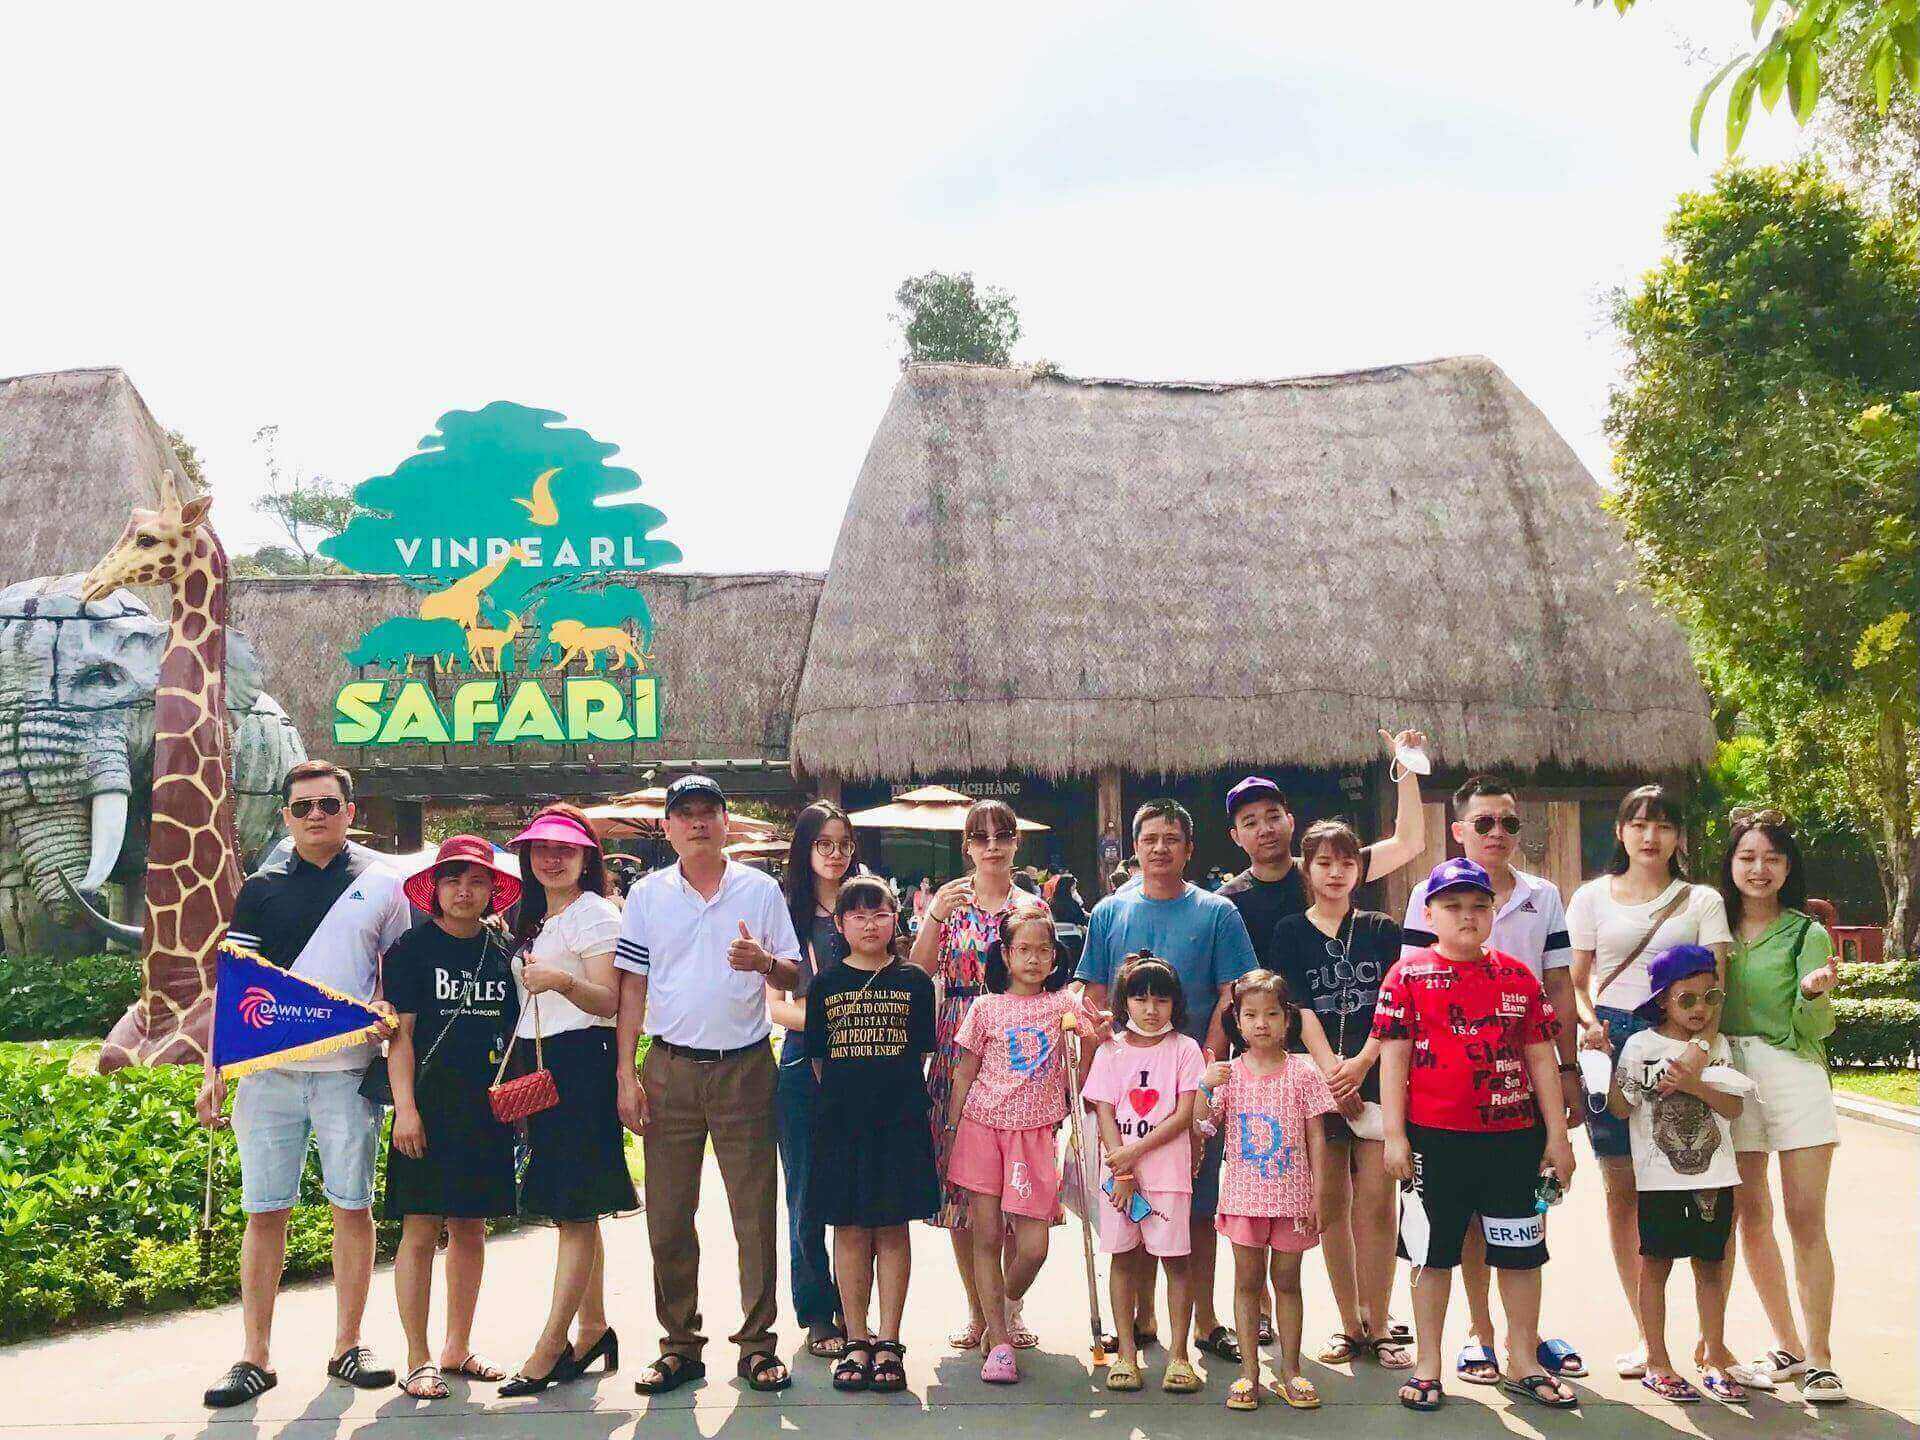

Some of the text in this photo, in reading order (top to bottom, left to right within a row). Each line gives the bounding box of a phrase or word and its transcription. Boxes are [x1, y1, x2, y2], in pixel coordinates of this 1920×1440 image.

[394, 536, 646, 568] VINPEARL
[333, 677, 662, 744] SAFARI
[1425, 979, 1449, 990] 21.7
[873, 990, 889, 1000] ALL
[260, 1003, 333, 1019] DAWN VIET
[862, 1002, 873, 1014] TO
[849, 1028, 885, 1043] PEOPLE
[1452, 1026, 1478, 1036] 15.6
[1139, 1070, 1149, 1088] I
